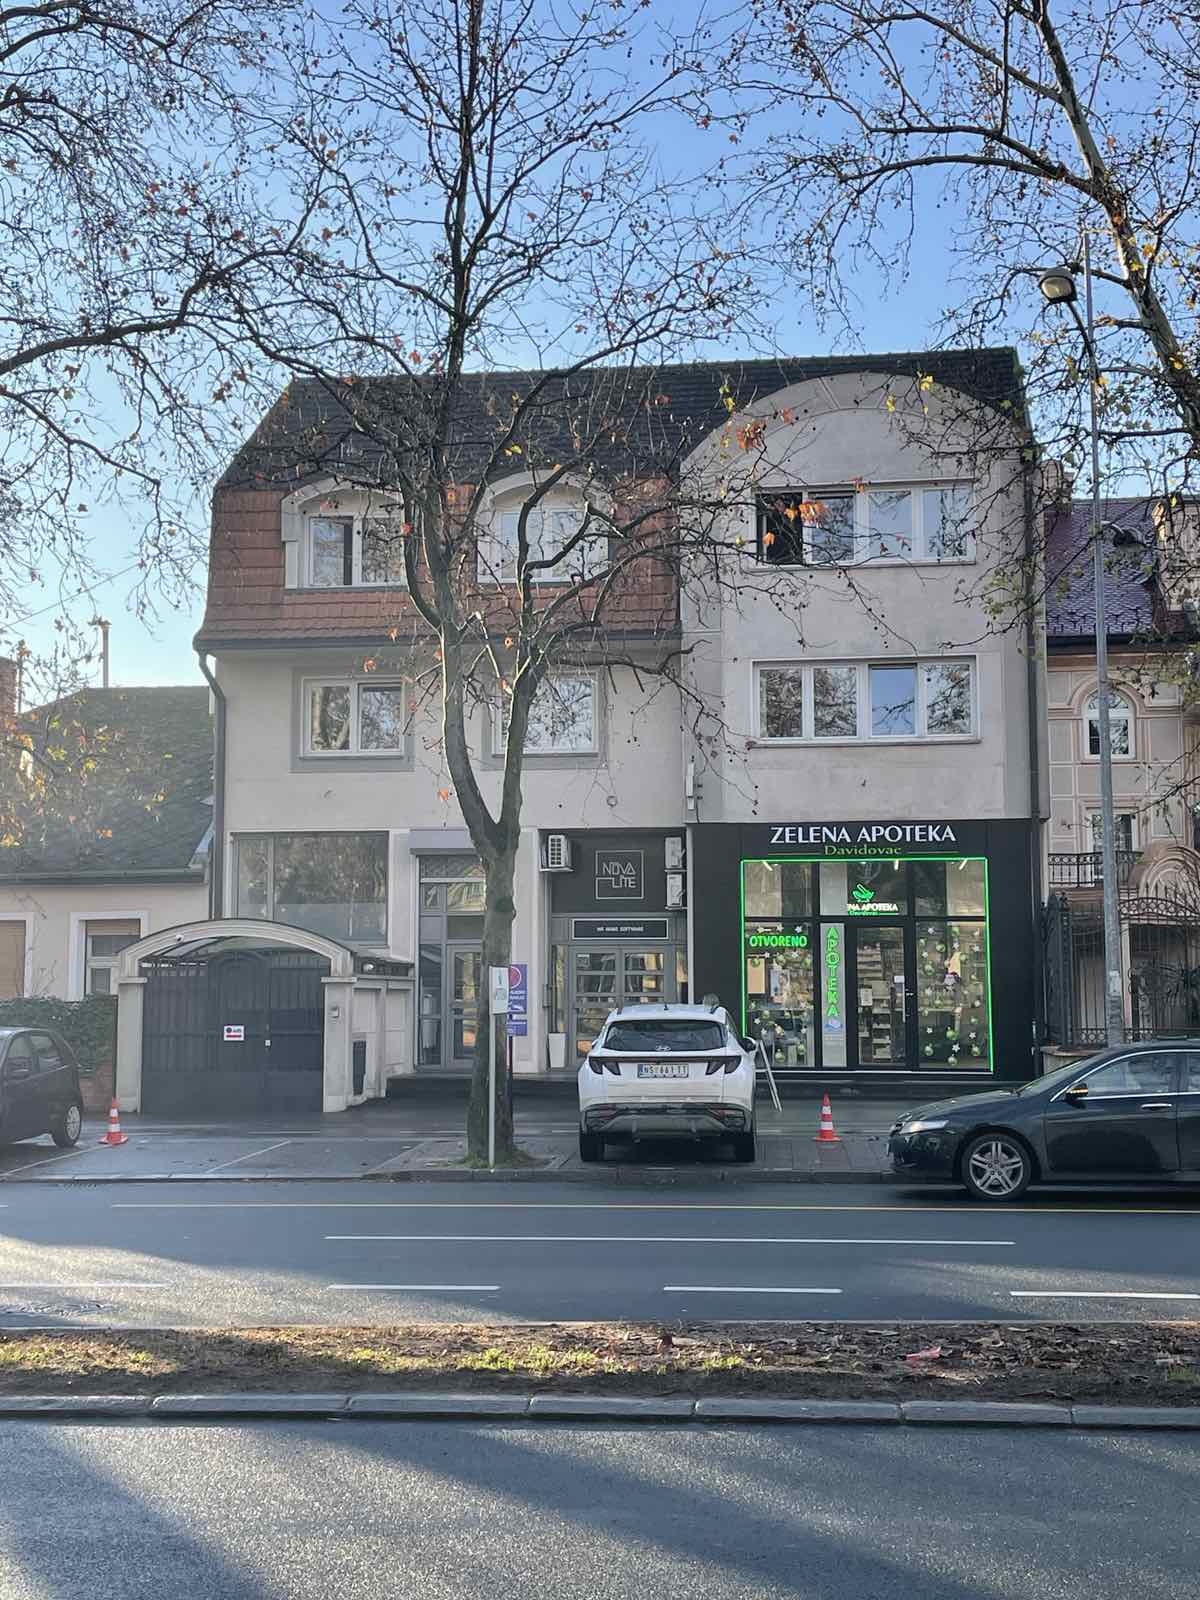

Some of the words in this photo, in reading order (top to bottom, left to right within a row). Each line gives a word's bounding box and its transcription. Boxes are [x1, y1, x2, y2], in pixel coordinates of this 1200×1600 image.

[770, 826, 851, 844] ZELENA
[857, 824, 956, 842] APOTEKA
[824, 844, 902, 856] Davidovac
[602, 862, 637, 875] NOVA
[612, 875, 637, 889] LITE
[862, 903, 899, 911] APOTEKA
[749, 935, 808, 948] OTVORENO
[825, 927, 840, 1017] APOTEKA
